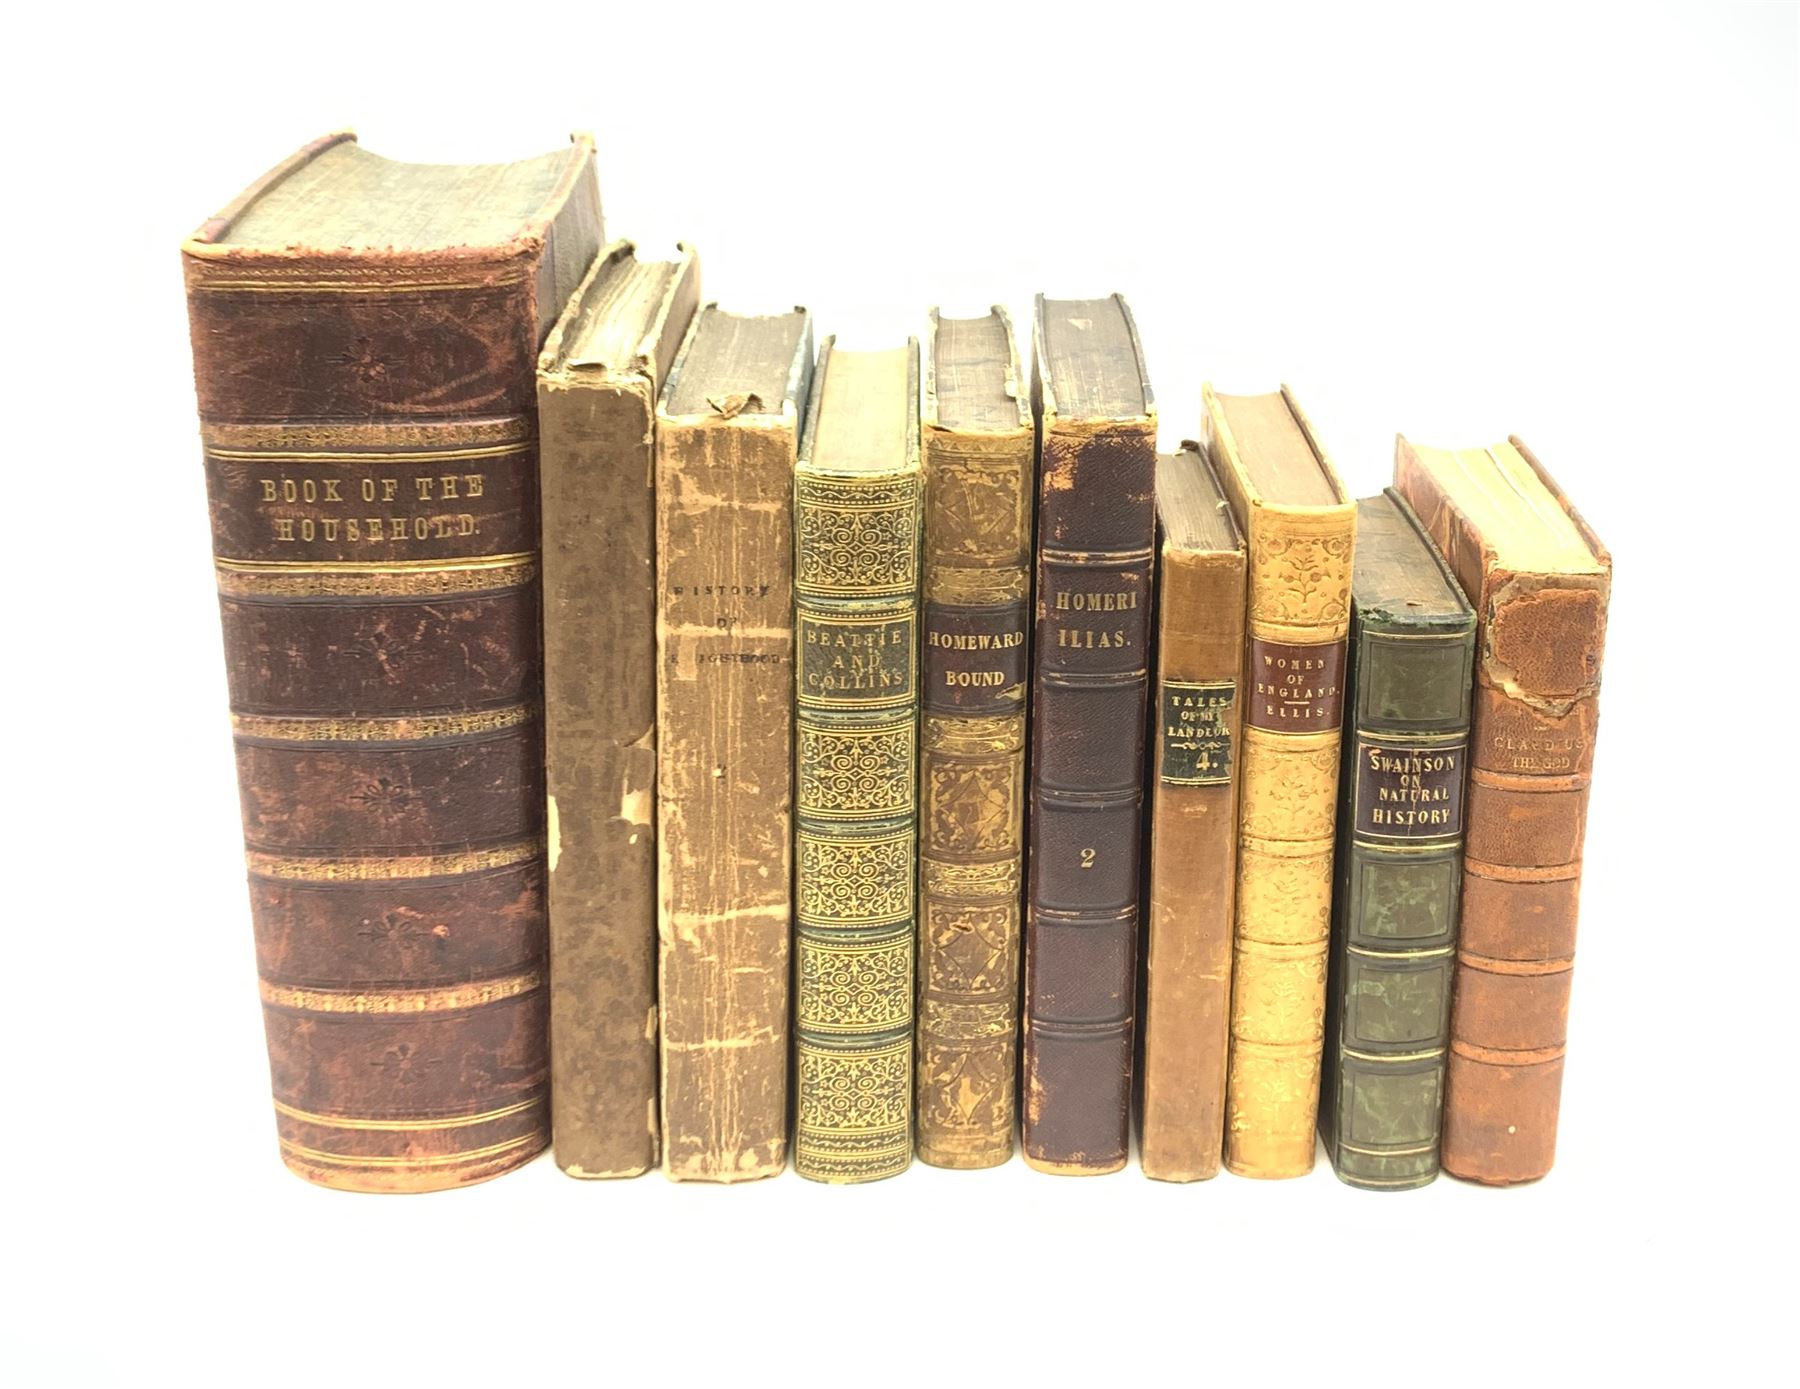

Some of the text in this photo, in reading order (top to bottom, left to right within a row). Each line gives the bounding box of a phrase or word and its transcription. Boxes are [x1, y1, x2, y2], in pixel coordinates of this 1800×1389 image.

[260, 474, 485, 503] BOOK OF THE
[275, 513, 481, 542] HOUSEHOLD.
[1055, 591, 1138, 611] HOMERI
[806, 629, 902, 647] BEATTIE
[928, 631, 1024, 650] HOMEWARD
[1058, 629, 1131, 649] ILIAS.
[833, 654, 880, 669] AND
[1264, 655, 1325, 670] WOMEN
[808, 672, 903, 690] COLLINS
[945, 670, 1005, 687] BOUND
[1286, 674, 1304, 685] OF
[1257, 682, 1340, 699] ENGLAND.
[1171, 695, 1227, 707] TALES
[1180, 711, 1195, 721] OF
[1266, 705, 1330, 718] ELLIS.
[1370, 755, 1456, 773] SWAINSON
[1400, 774, 1421, 788] ON
[1379, 787, 1450, 802] NATURAL
[1372, 808, 1451, 825] HISTORY
[1080, 847, 1096, 869] 2
